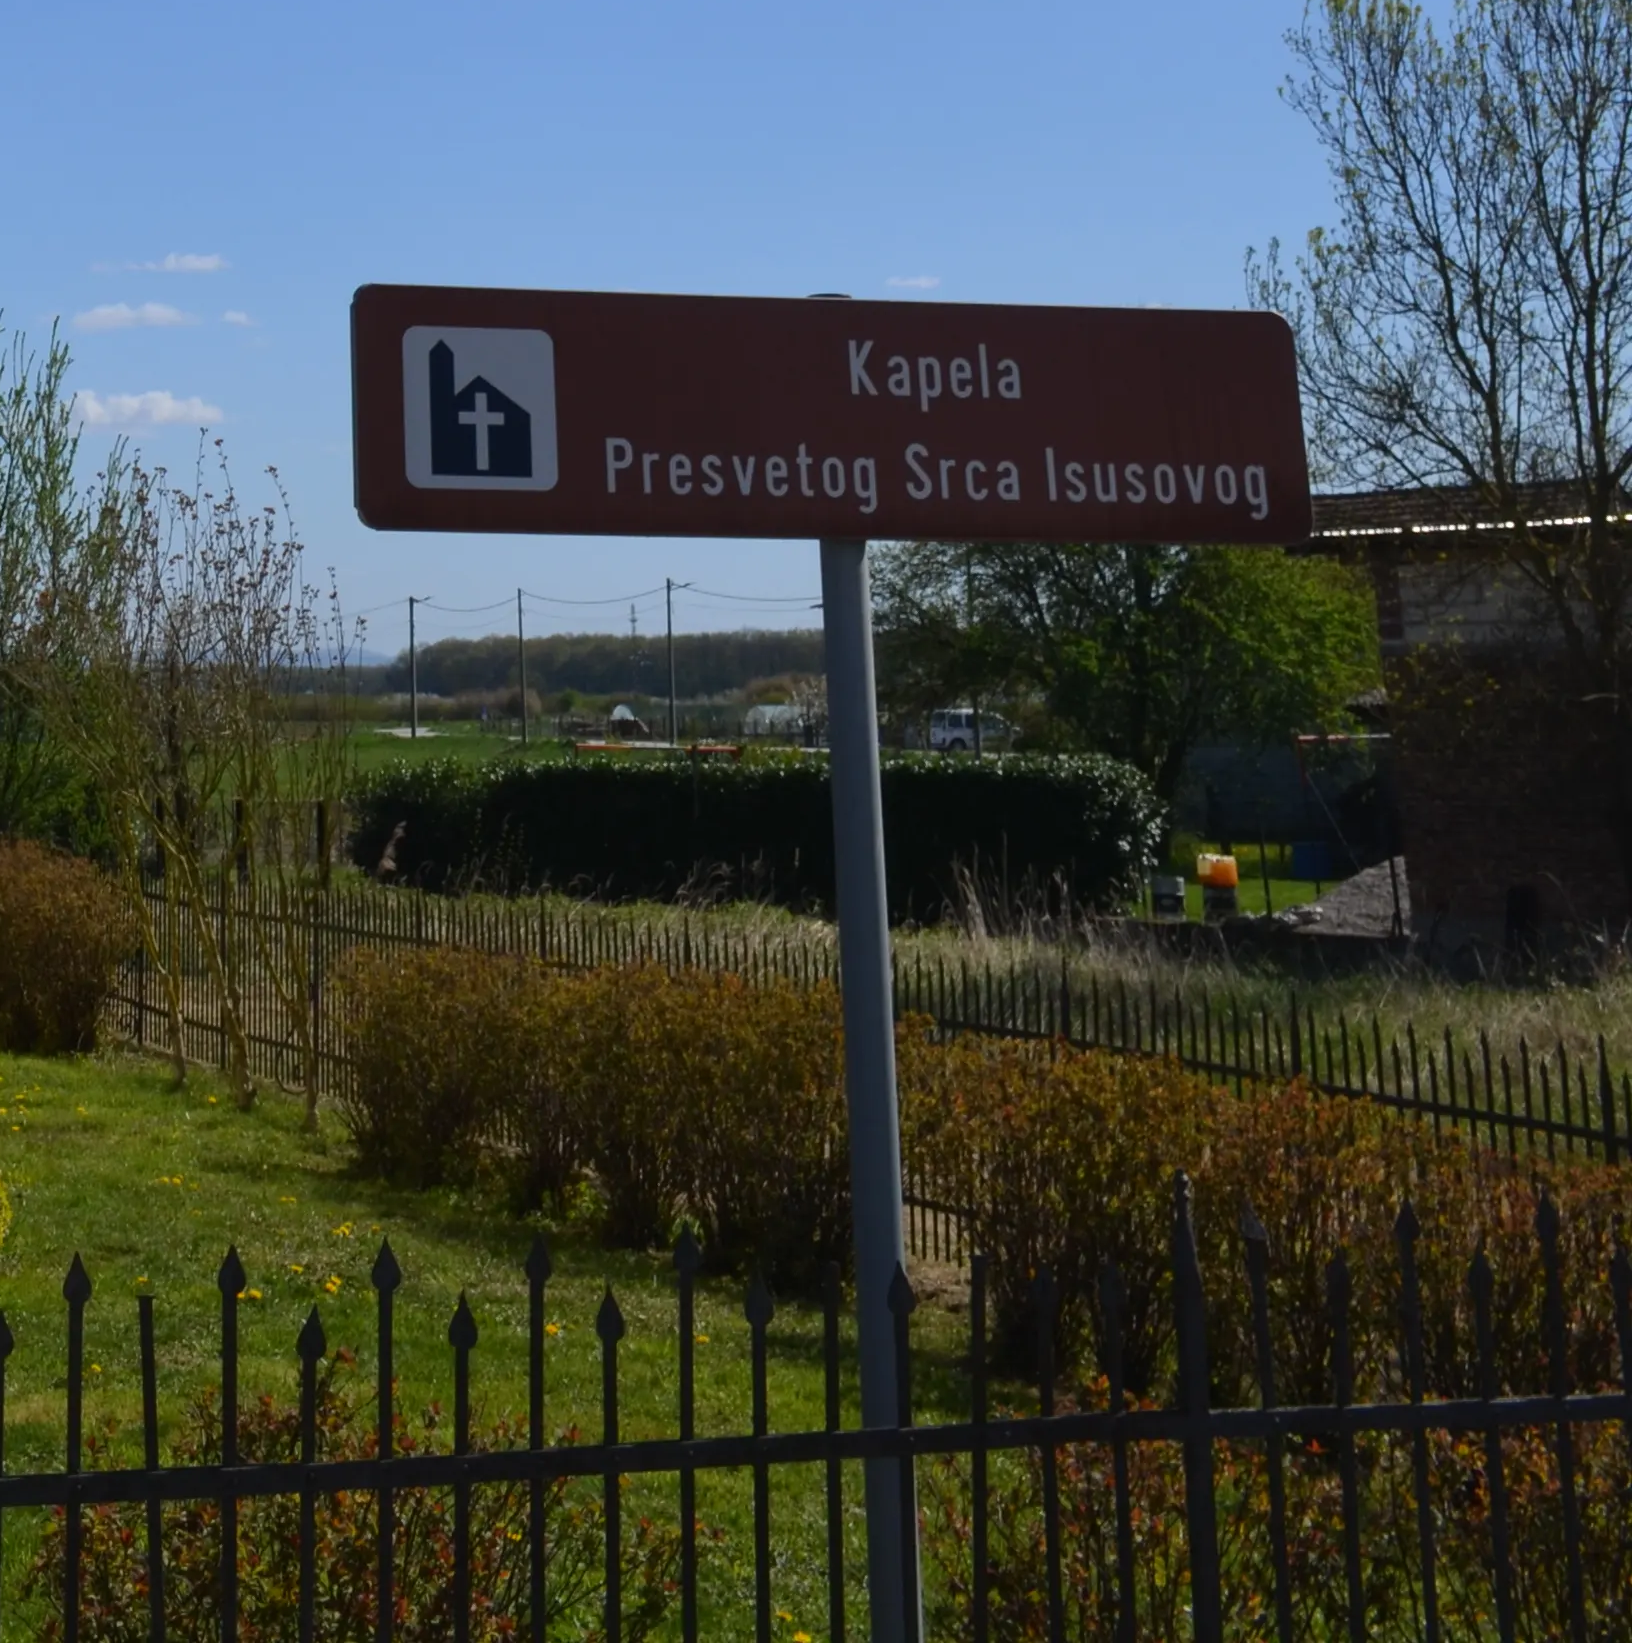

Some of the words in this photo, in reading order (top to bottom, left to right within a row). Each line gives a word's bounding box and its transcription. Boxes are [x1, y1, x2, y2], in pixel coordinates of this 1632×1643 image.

[847, 338, 1023, 412] Kapela
[604, 436, 879, 515] Presvetog
[904, 441, 1021, 502] Srca
[1044, 446, 1269, 521] Isusovog
